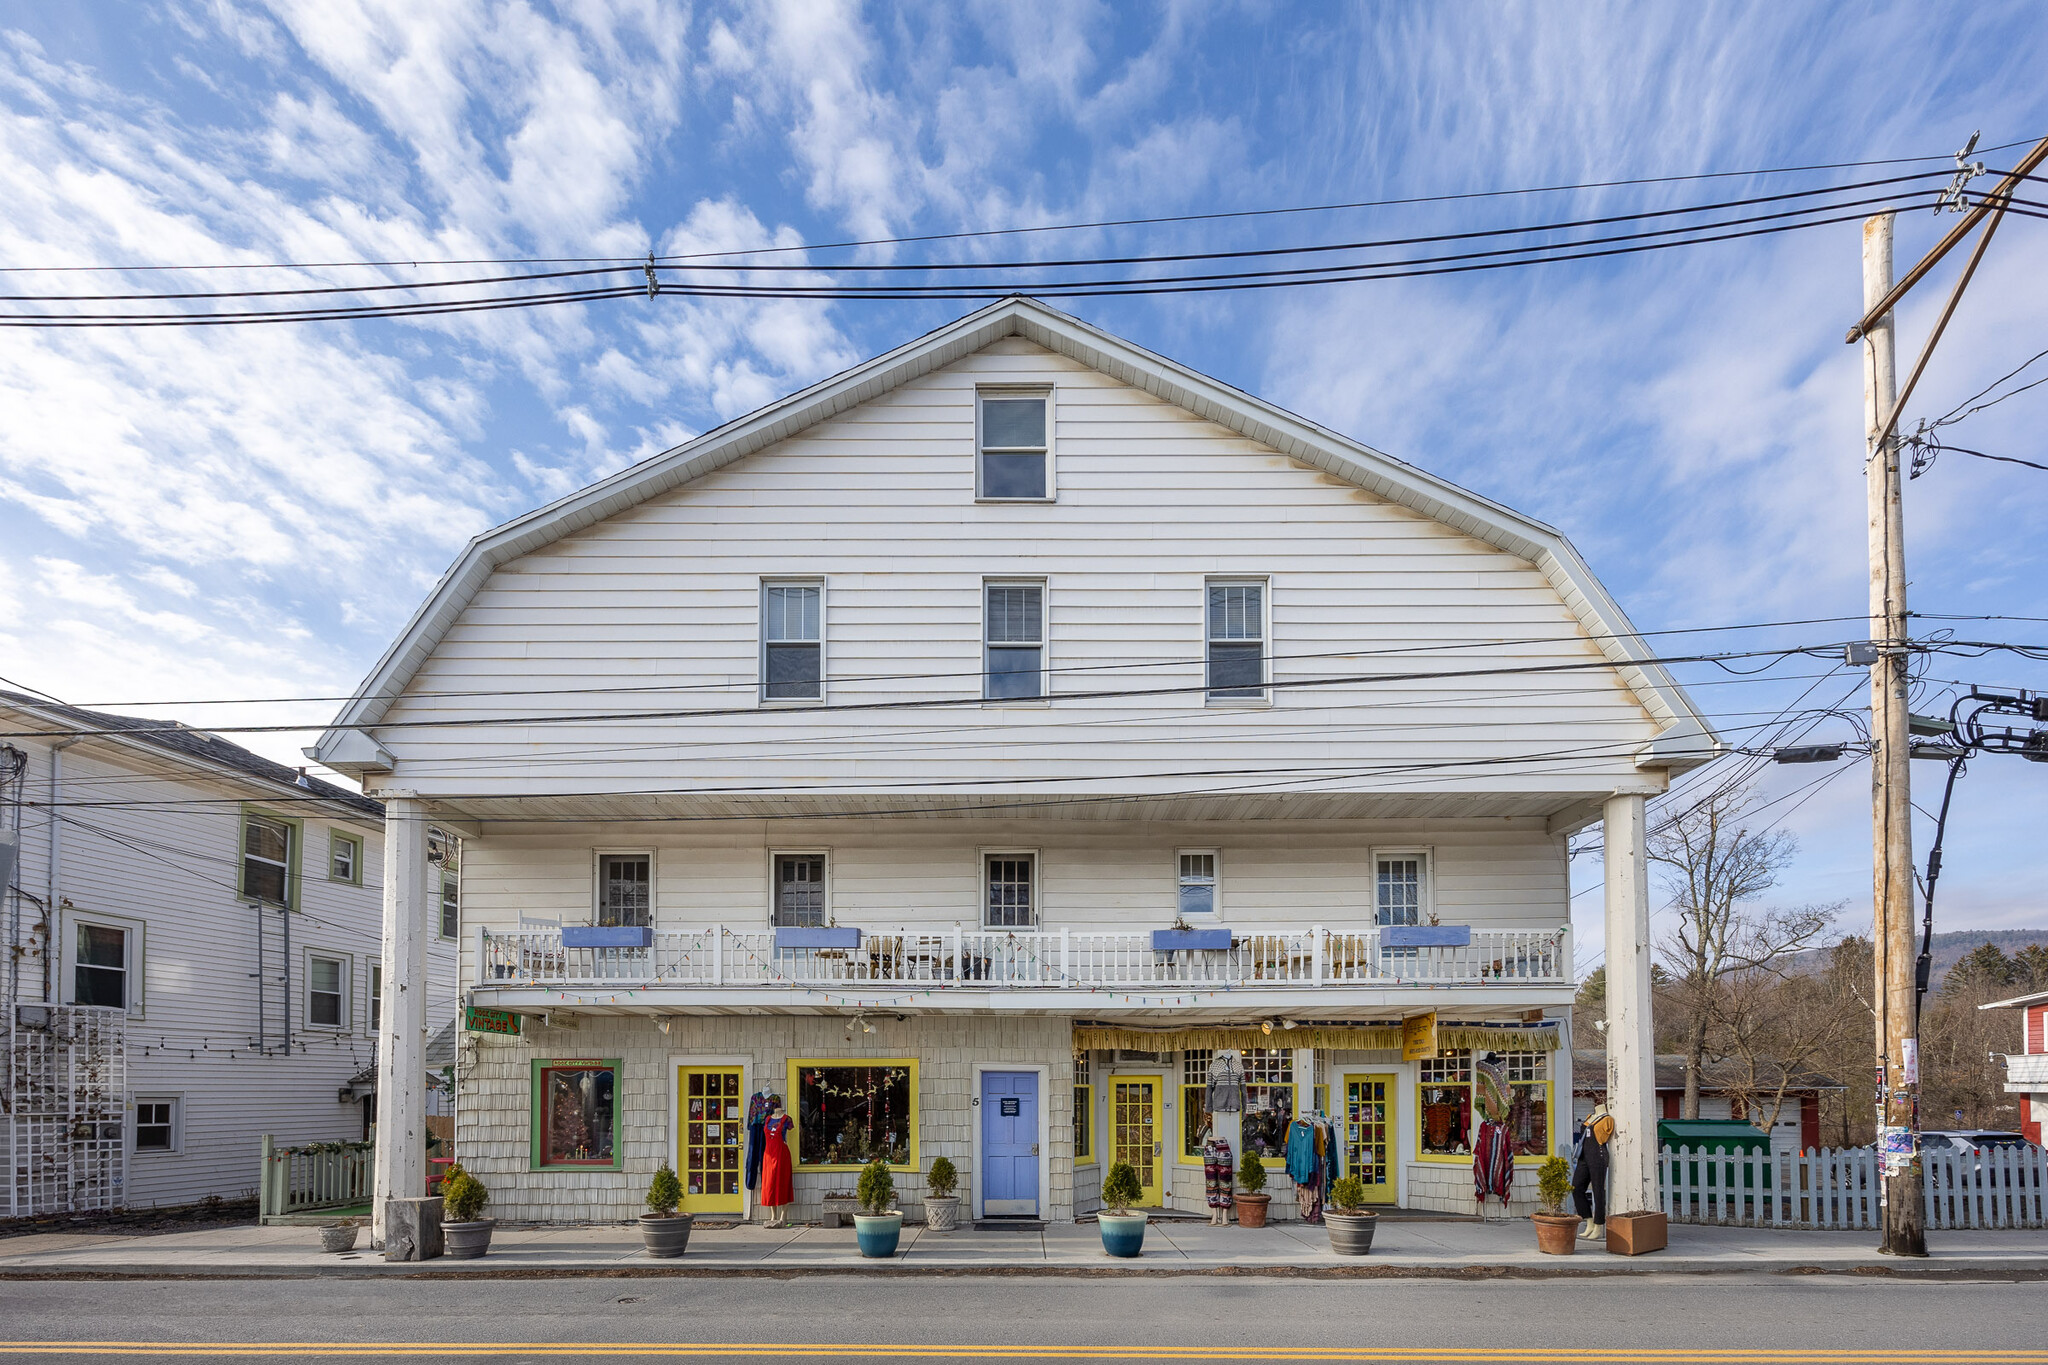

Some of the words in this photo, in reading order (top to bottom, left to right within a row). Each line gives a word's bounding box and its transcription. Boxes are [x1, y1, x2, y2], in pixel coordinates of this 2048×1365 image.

[474, 1009, 489, 1017] ROCK
[490, 1011, 502, 1019] CITY
[468, 1016, 508, 1032] VINTAGE
[972, 1097, 979, 1106] 5
